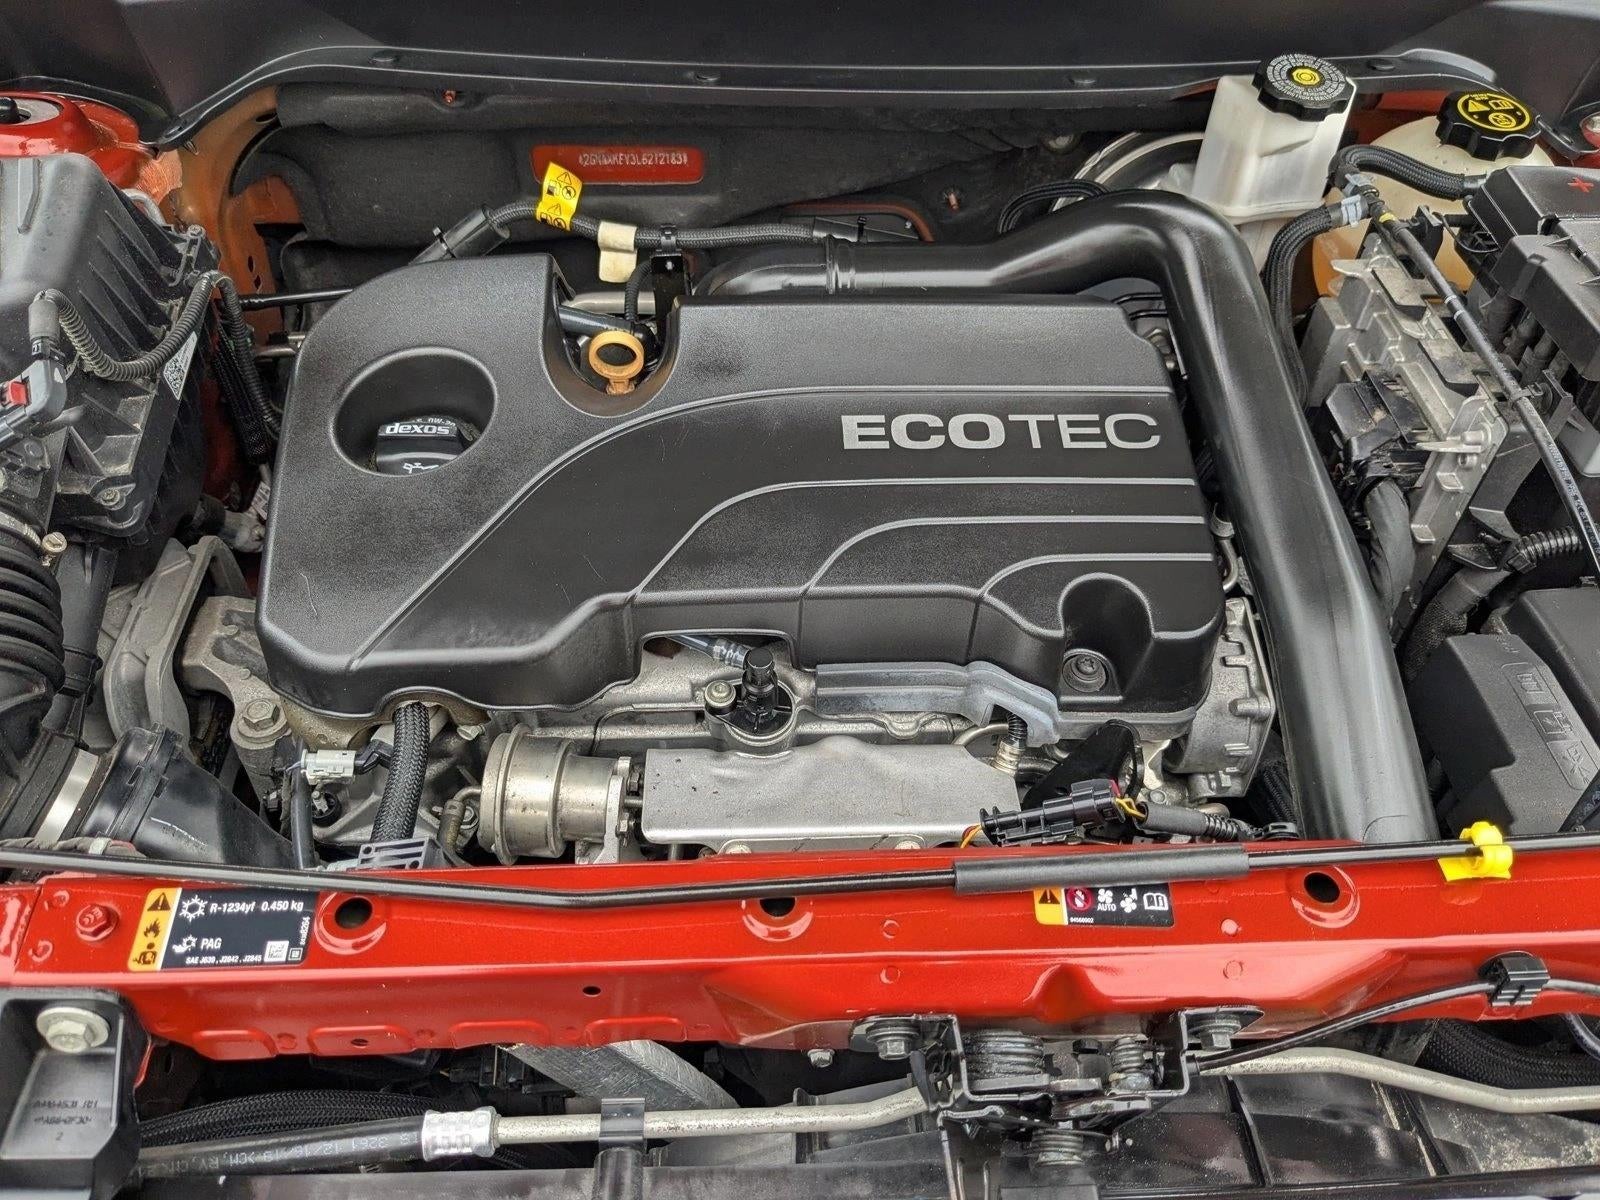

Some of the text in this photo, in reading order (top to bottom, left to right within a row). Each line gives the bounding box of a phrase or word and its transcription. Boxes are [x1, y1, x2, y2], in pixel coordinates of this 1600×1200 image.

[385, 422, 451, 435] dexos
[841, 413, 1161, 450] ECOTEC
[209, 900, 304, 914] R-1234yf 0.450 kg
[1097, 903, 1117, 911] AUTO
[200, 937, 222, 949] PAG
[185, 956, 200, 965] SAE
[351, 1137, 389, 1152] 3261
